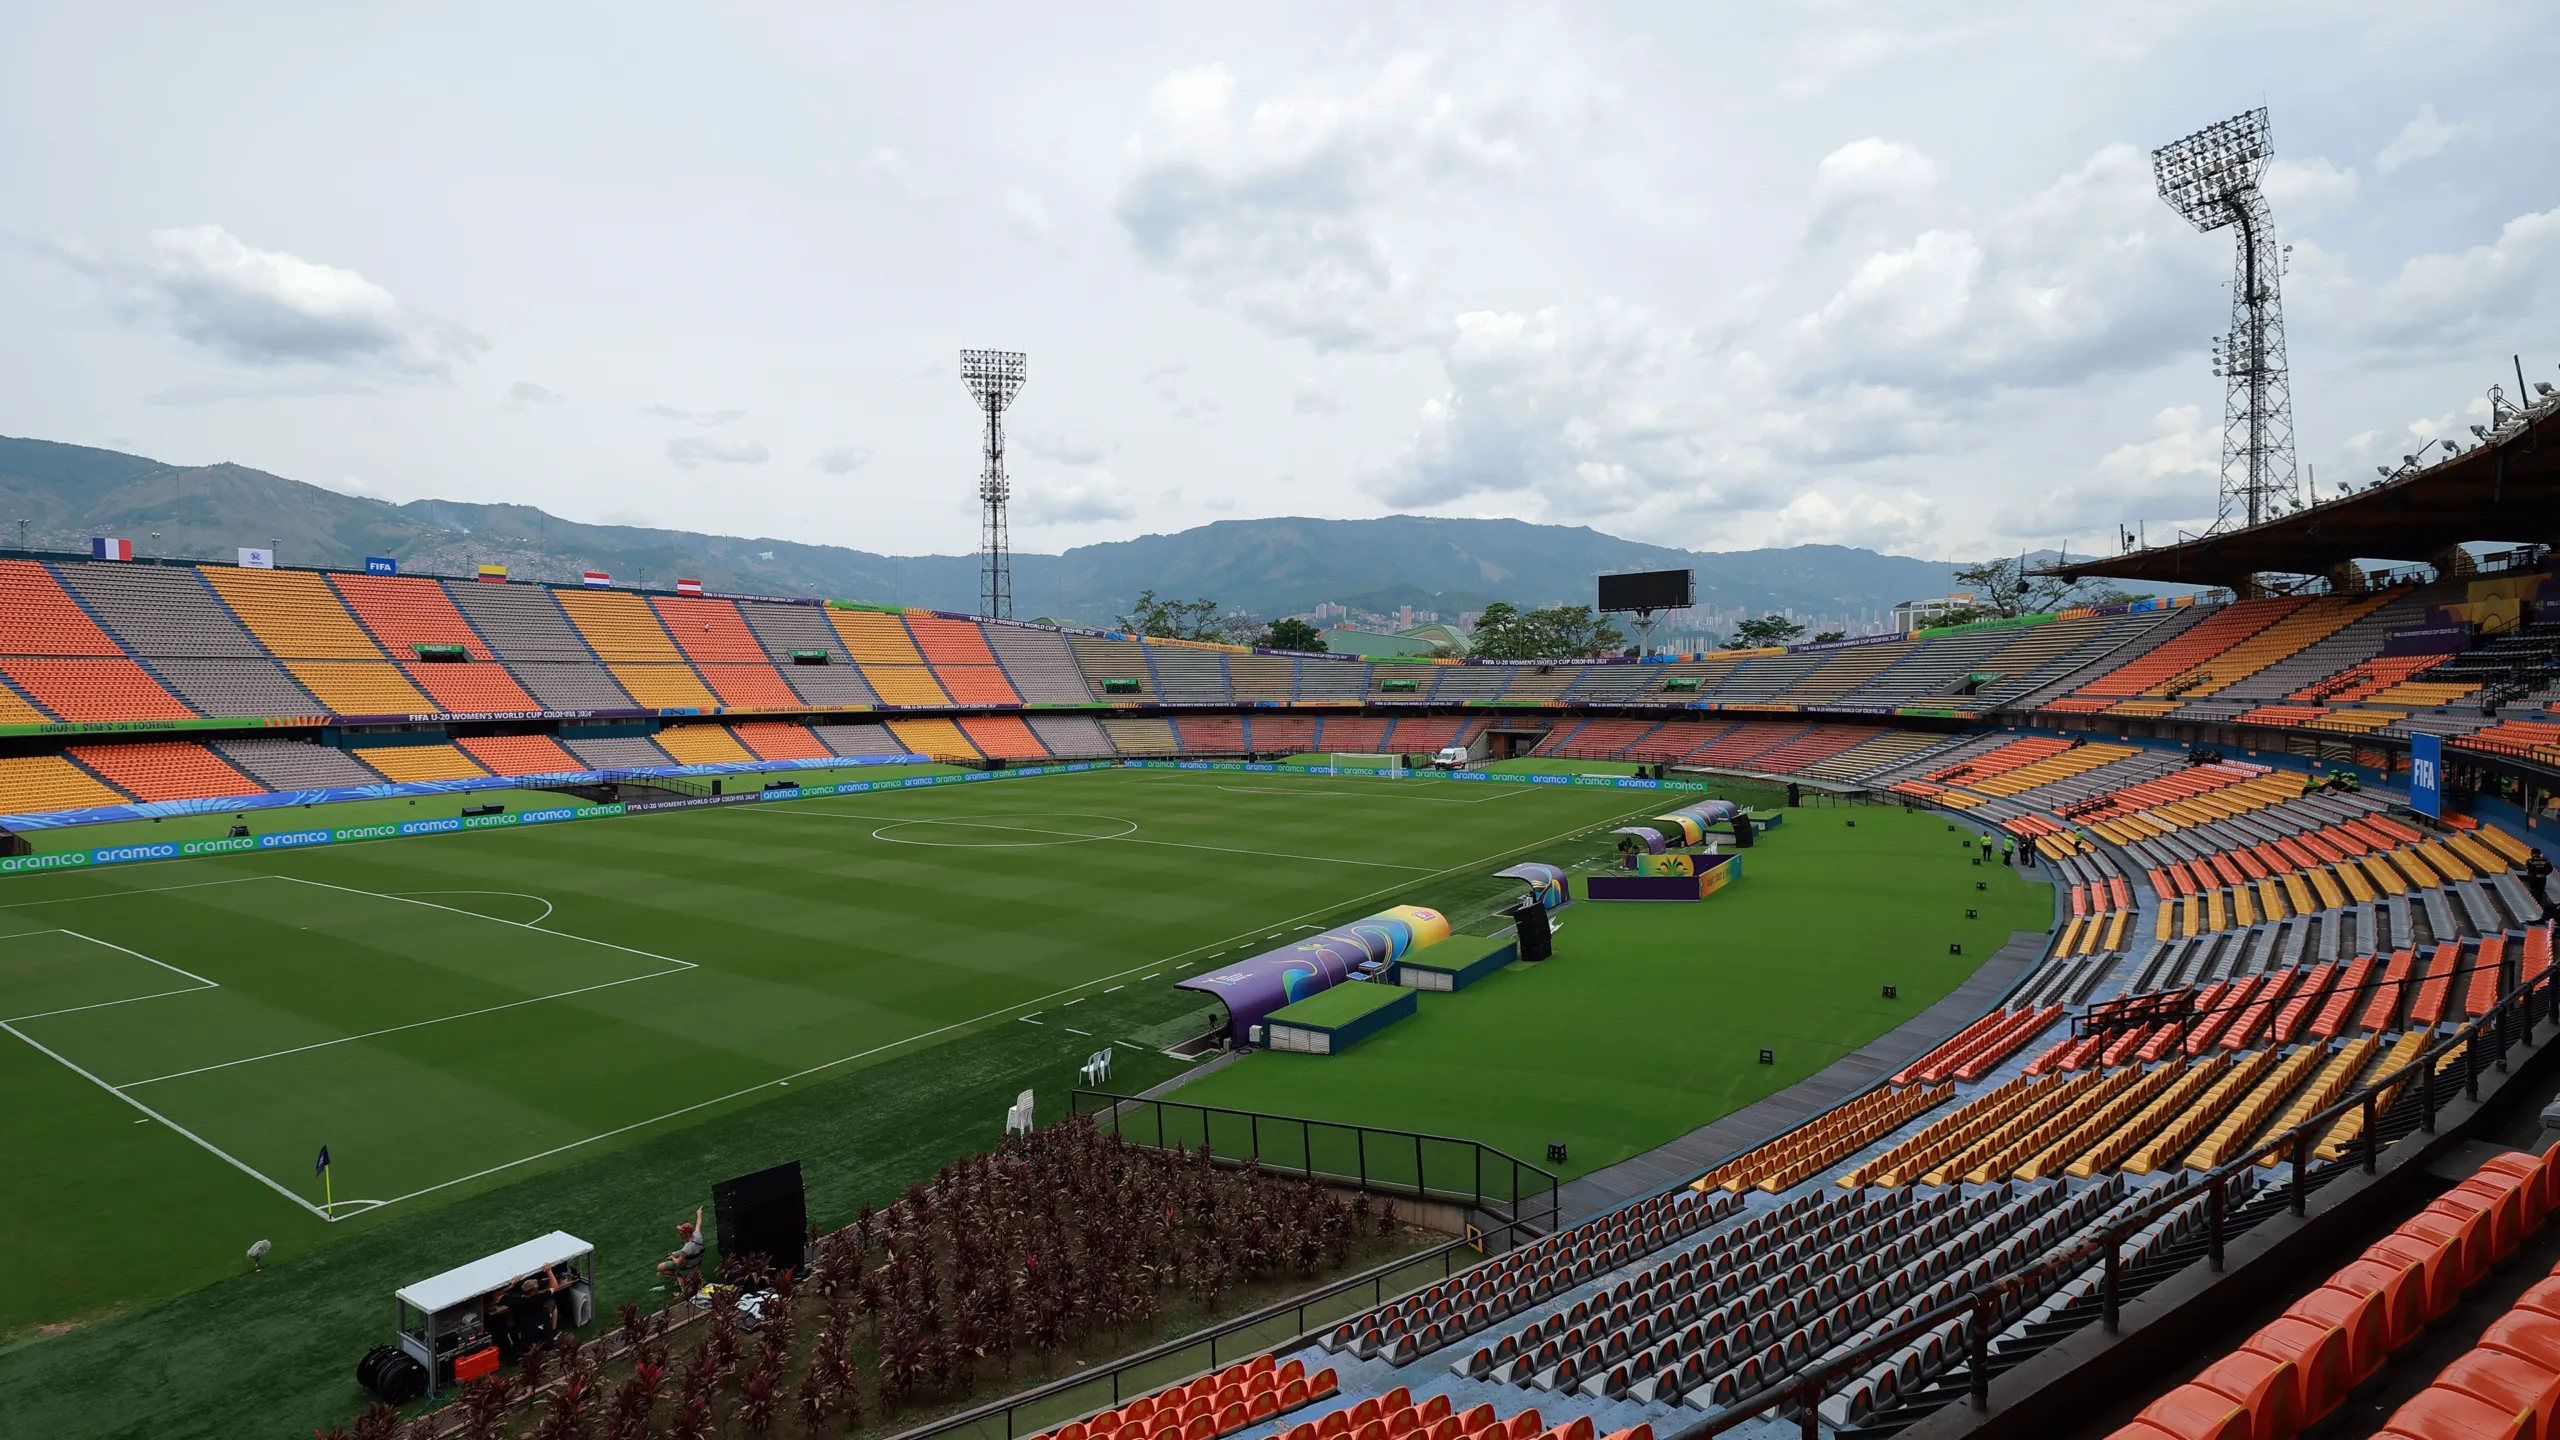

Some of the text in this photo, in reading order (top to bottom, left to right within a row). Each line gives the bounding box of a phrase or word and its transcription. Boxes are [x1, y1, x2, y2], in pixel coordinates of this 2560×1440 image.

[369, 562, 392, 572] FIFA
[452, 712, 493, 720] WOMEN'S
[1019, 767, 1042, 776] aramco
[1044, 765, 1066, 774] aramco
[1068, 764, 1089, 772] aramco
[1277, 765, 1305, 773] aramco
[1310, 766, 1338, 774] aramo
[1343, 768, 1373, 776] aramco
[965, 773, 990, 781] aramco
[992, 769, 1017, 778] aramco
[1416, 770, 1446, 779] aramco
[1454, 772, 1486, 781] aramco
[1492, 773, 1526, 782] aramco
[2414, 758, 2435, 790] FIFA
[873, 780, 902, 789] aramco
[905, 777, 933, 786] aramco
[936, 775, 962, 784] aramco
[1532, 775, 1568, 784] aramco
[1575, 776, 1611, 786] aramco
[1618, 778, 1656, 788] aramco
[803, 786, 835, 796] aramco
[839, 783, 869, 793] aramco
[764, 789, 799, 800] aramco
[658, 800, 687, 808] WOMEN'S
[687, 798, 709, 806] WORLD
[524, 808, 572, 822] aramco
[578, 804, 622, 818] aramco
[466, 814, 517, 827] aramco
[404, 819, 459, 833] aramco
[336, 825, 396, 841] aramco
[263, 831, 328, 847] aramco
[184, 838, 254, 854] aramco
[97, 845, 173, 862] aramco
[2, 853, 85, 871] aramco
